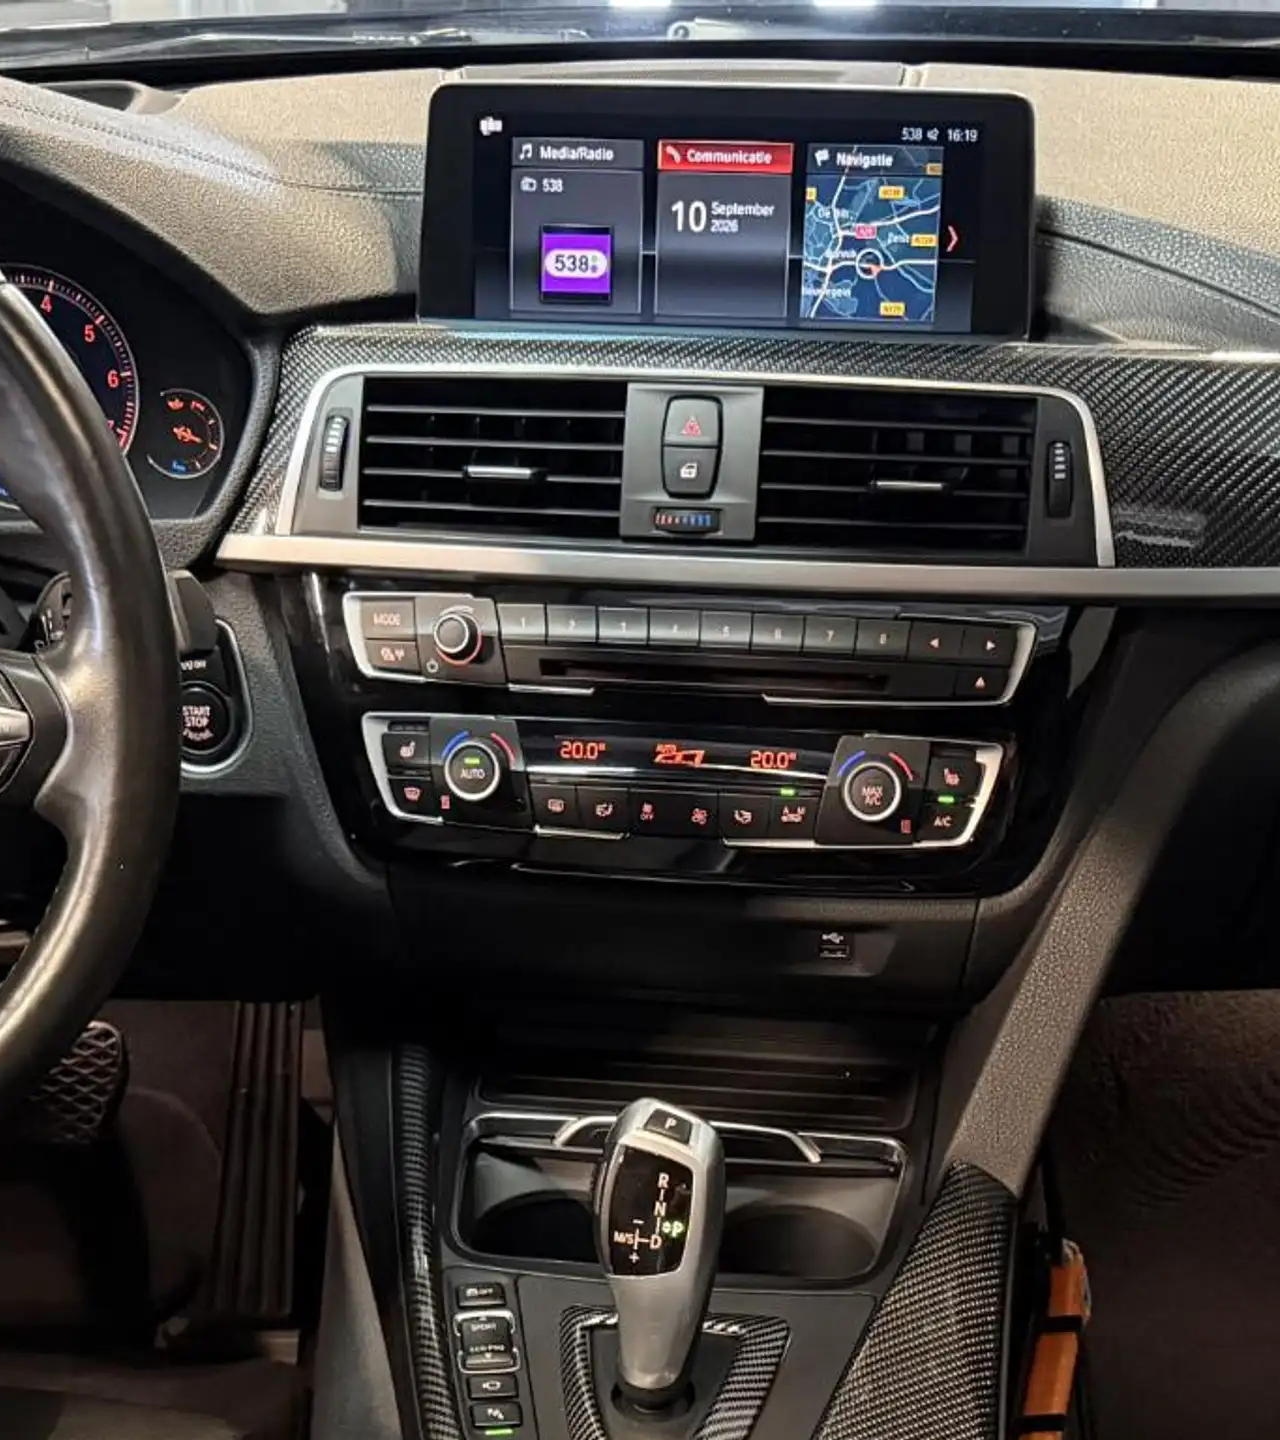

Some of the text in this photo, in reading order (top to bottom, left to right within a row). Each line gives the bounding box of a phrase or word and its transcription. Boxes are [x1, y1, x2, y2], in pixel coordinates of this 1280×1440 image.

[901, 128, 922, 141] 538
[947, 129, 978, 142] 16:19
[539, 145, 614, 161] Media/Radio
[686, 148, 772, 164] Communicatie
[836, 152, 894, 169] Navigatie
[542, 178, 564, 193] 538
[671, 200, 707, 233] 10
[711, 201, 775, 217] September
[710, 219, 739, 233] 2026
[554, 254, 589, 272] 538
[40, 295, 52, 313] 4
[84, 324, 95, 342] 5
[107, 371, 120, 388] 6
[373, 611, 402, 627] MODE
[826, 629, 835, 642] 7
[182, 704, 211, 717] START
[183, 716, 210, 728] STOP
[459, 768, 486, 780] AUTO
[861, 785, 884, 796] MAX
[864, 795, 882, 806] A/C
[933, 815, 953, 828] A/C
[664, 1117, 677, 1130] P
[657, 1172, 670, 1189] R
[654, 1201, 667, 1217] N
[649, 1234, 662, 1249] D
[471, 1322, 497, 1332] SPORT
